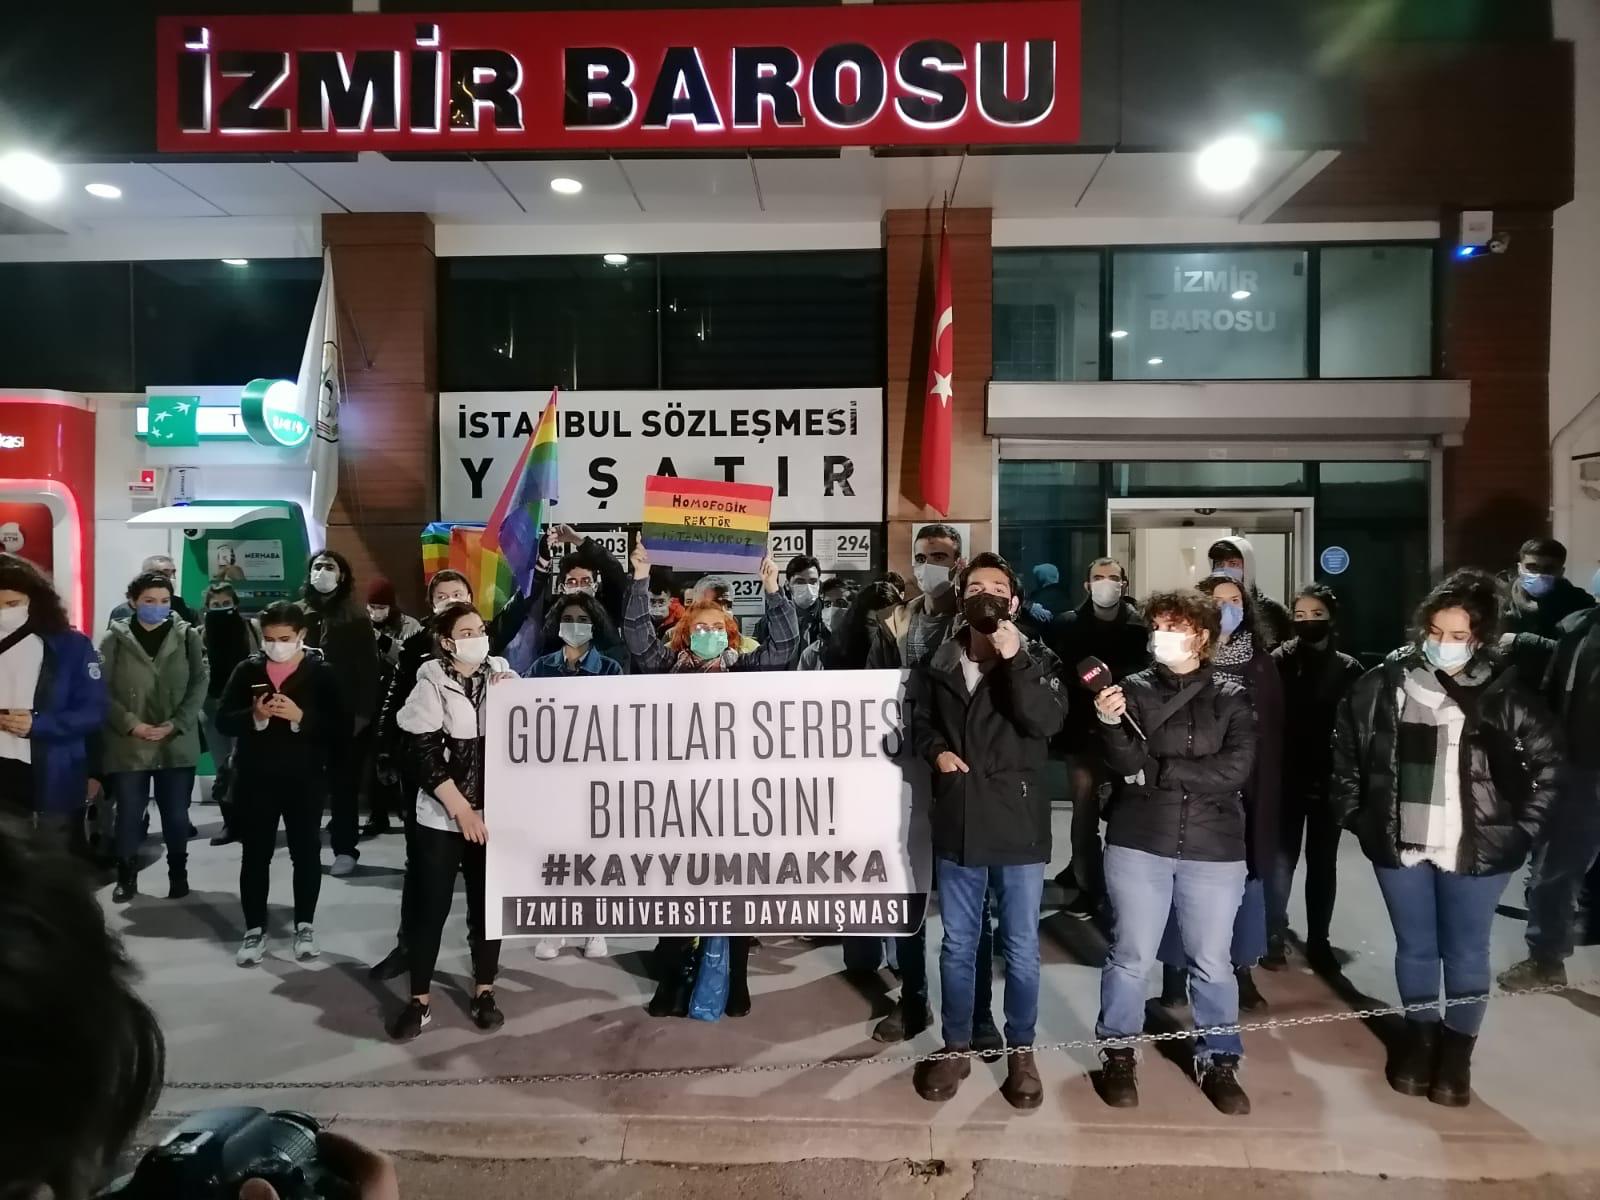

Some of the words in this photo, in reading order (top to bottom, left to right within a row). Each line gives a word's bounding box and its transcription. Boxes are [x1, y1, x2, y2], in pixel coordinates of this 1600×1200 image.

[177, 24, 525, 134] İZMİR
[564, 39, 1056, 132] BAROSU
[1174, 266, 1256, 293] İZMİR
[1152, 310, 1275, 332] BAROSU
[642, 401, 857, 443] SÖZLEŞMESİ
[460, 455, 856, 509] YŞTIR
[773, 536, 804, 551] 210
[837, 536, 869, 551] 294
[732, 580, 763, 595] 237
[508, 697, 736, 763] GÖZALTILAR
[590, 777, 835, 839] BIRAKILSIN!
[541, 849, 888, 886] #KAYYUMNAKKA
[516, 898, 583, 927] İZMİR
[596, 897, 732, 927] ÜNİVERSİTE
[745, 899, 909, 932] DAYANIŞMASI
